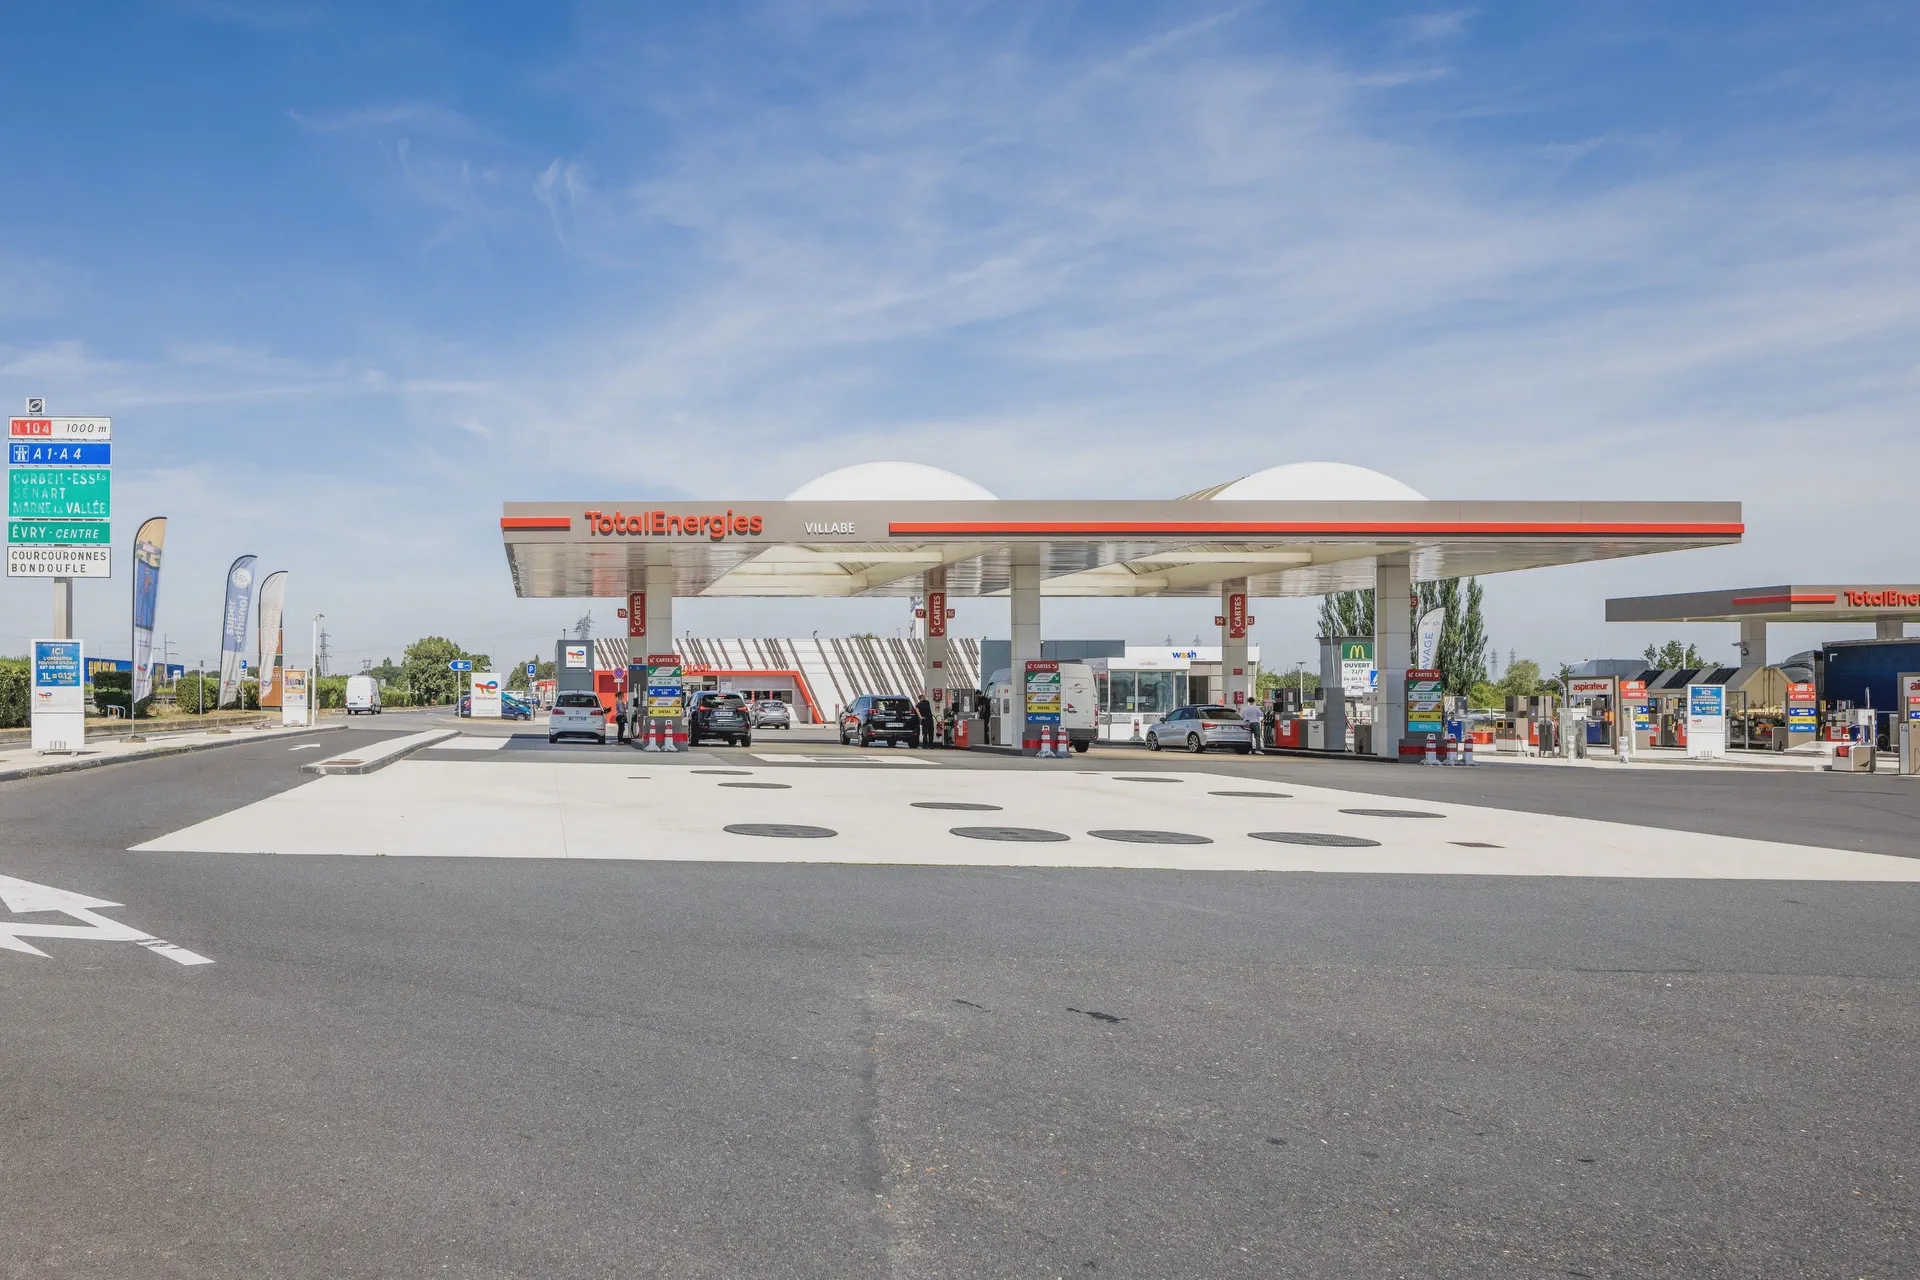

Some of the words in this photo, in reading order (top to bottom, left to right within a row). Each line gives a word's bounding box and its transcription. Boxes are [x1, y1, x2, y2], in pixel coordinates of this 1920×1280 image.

[66, 424, 94, 432] 1000
[13, 502, 51, 514] MARNE
[66, 500, 106, 514] VALLÉE
[585, 508, 763, 539] TotalEnergies
[804, 522, 855, 534] VILLABE
[12, 551, 106, 560] COURCOURONNES
[12, 564, 86, 572] BONDOUFLE
[1844, 590, 1920, 606] TotalEne
[227, 599, 236, 634] super
[234, 594, 248, 643] ethanol
[1172, 650, 1196, 658] wash
[1422, 632, 1434, 670] AVAGE
[1573, 682, 1608, 692] aspirateur
